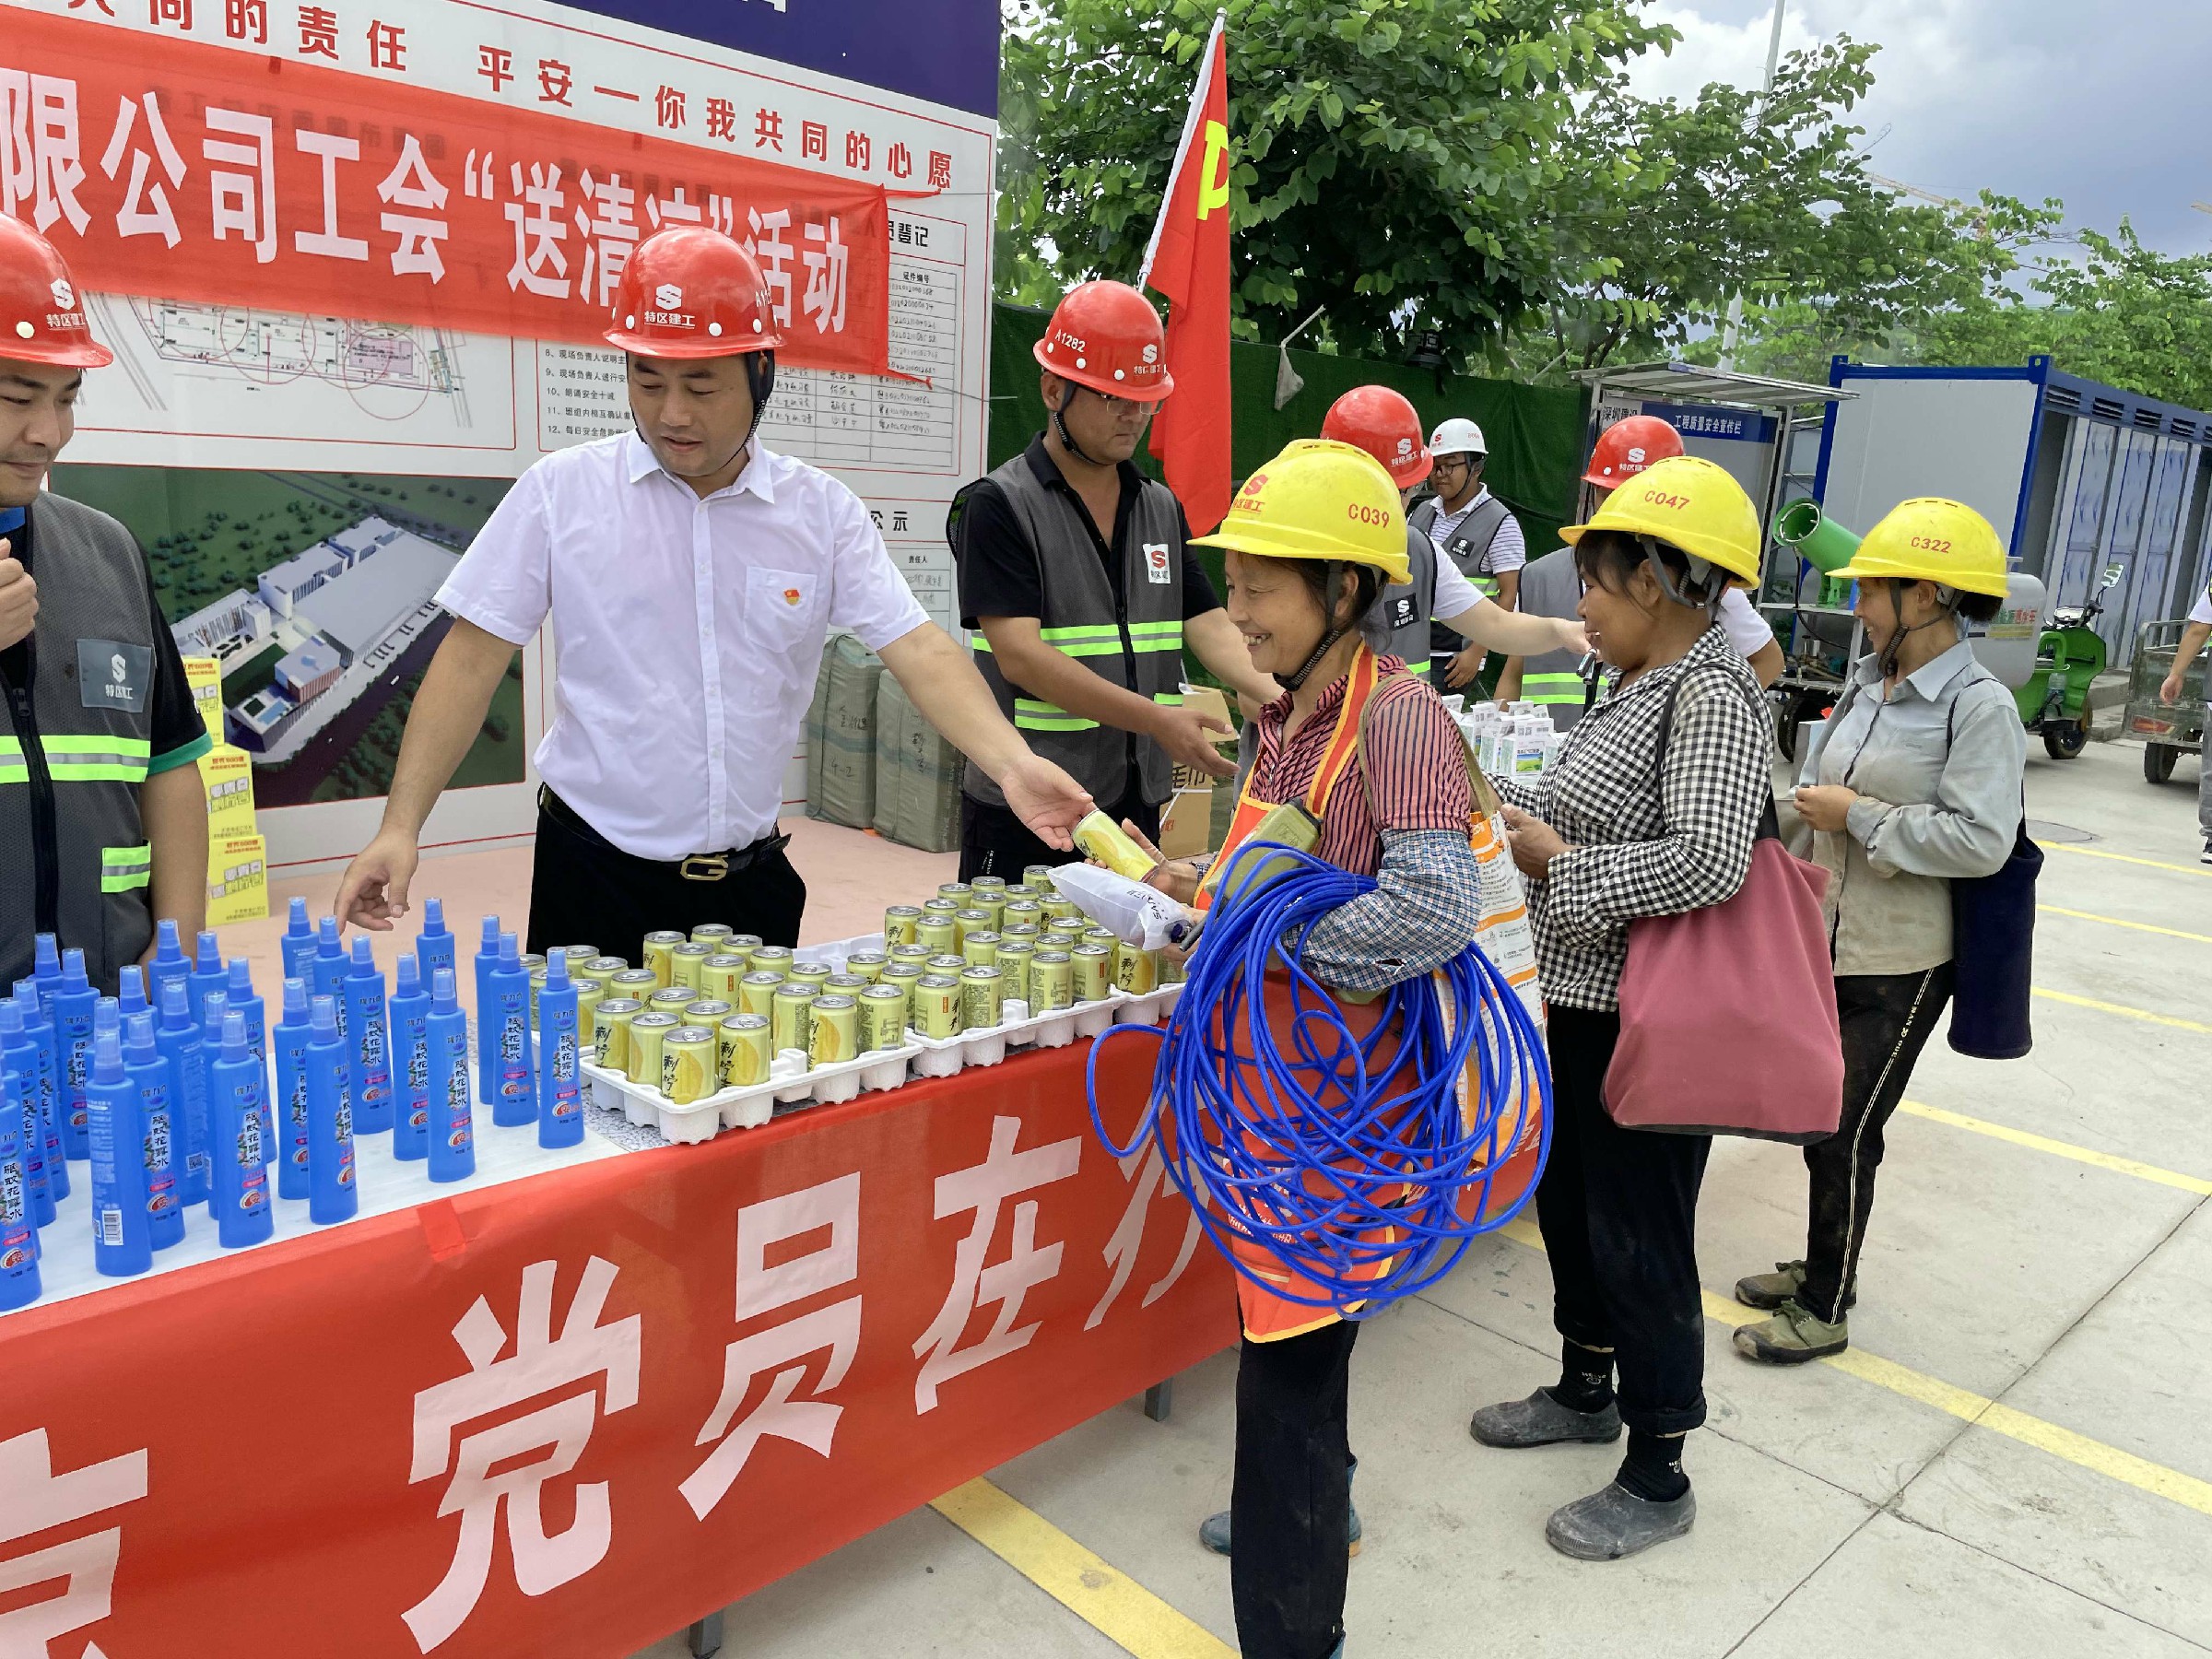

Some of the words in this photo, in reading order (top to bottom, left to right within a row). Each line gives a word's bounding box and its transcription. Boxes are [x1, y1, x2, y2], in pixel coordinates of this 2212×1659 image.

[644, 311, 695, 326] 特区建工
[1054, 329, 1086, 353] A1282
[1674, 415, 1742, 434] 工程质量安全宣传栏
[1645, 490, 1689, 510] C047
[1348, 503, 1389, 528] C039
[1911, 536, 1951, 554] C322
[908, 556, 928, 564] 责任人
[595, 1026, 613, 1068] 刺柠
